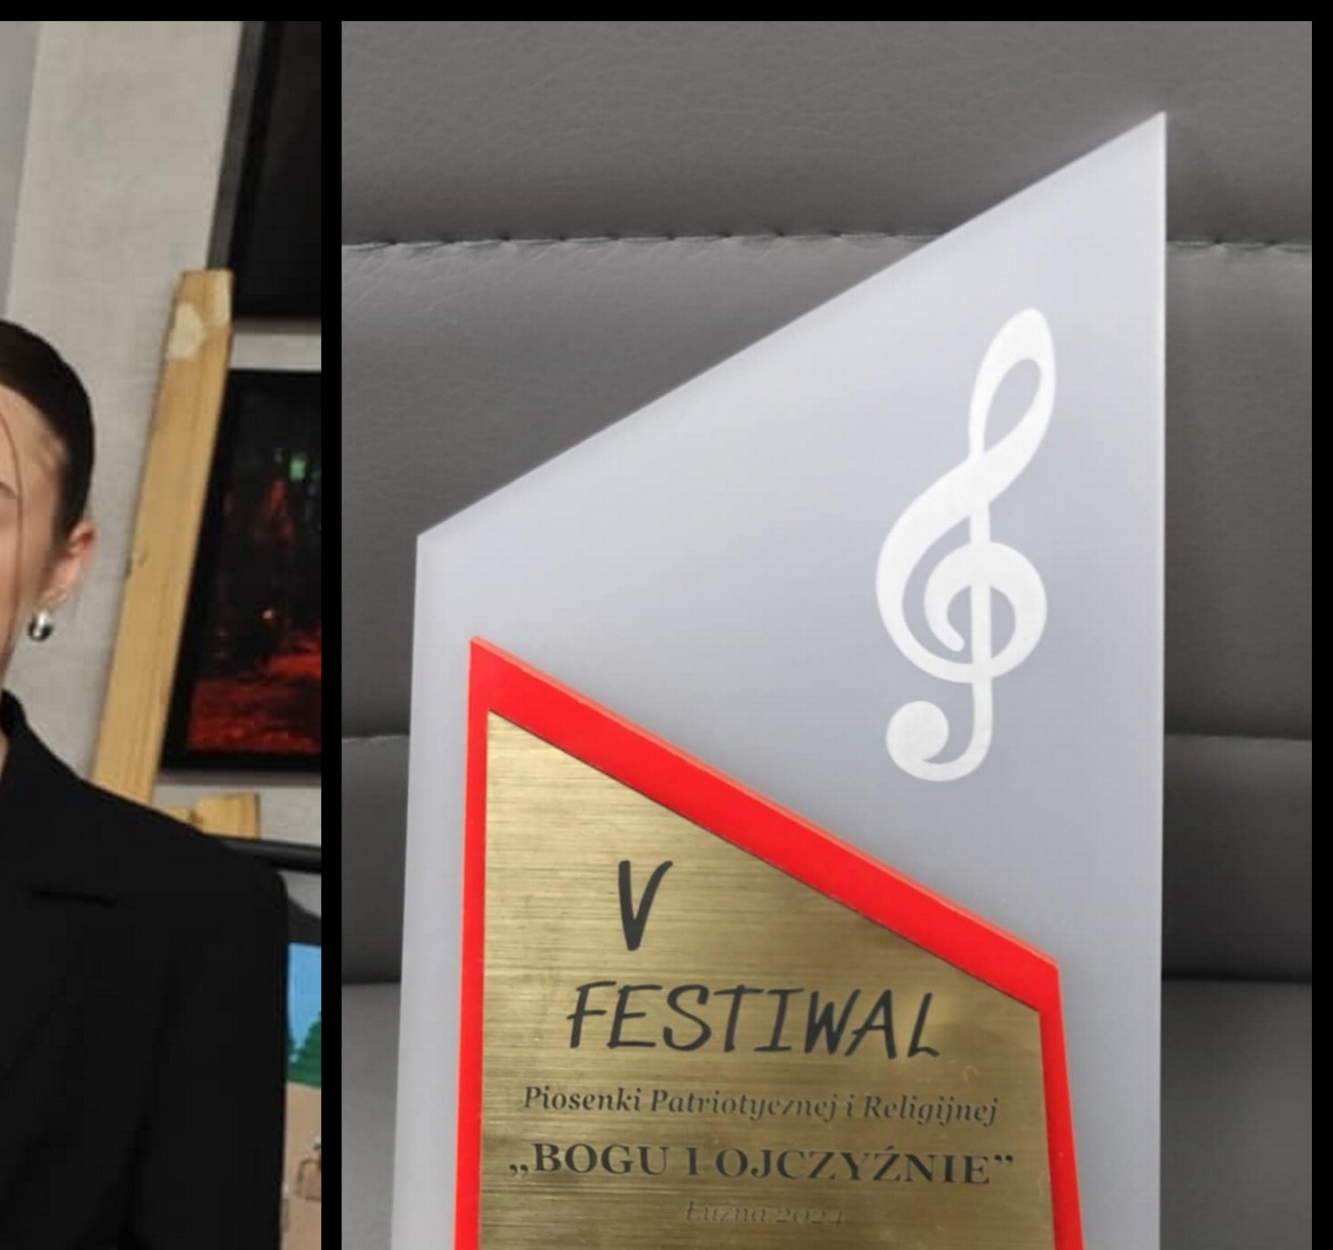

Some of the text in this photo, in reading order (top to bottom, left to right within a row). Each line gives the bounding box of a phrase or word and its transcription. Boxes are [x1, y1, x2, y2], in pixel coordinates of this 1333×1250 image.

[617, 860, 673, 951] V
[566, 981, 941, 1059] FESTIWAL
[524, 1085, 999, 1127] Piosenki Patriotycznej i Religijnej
[685, 1147, 699, 1176] I
